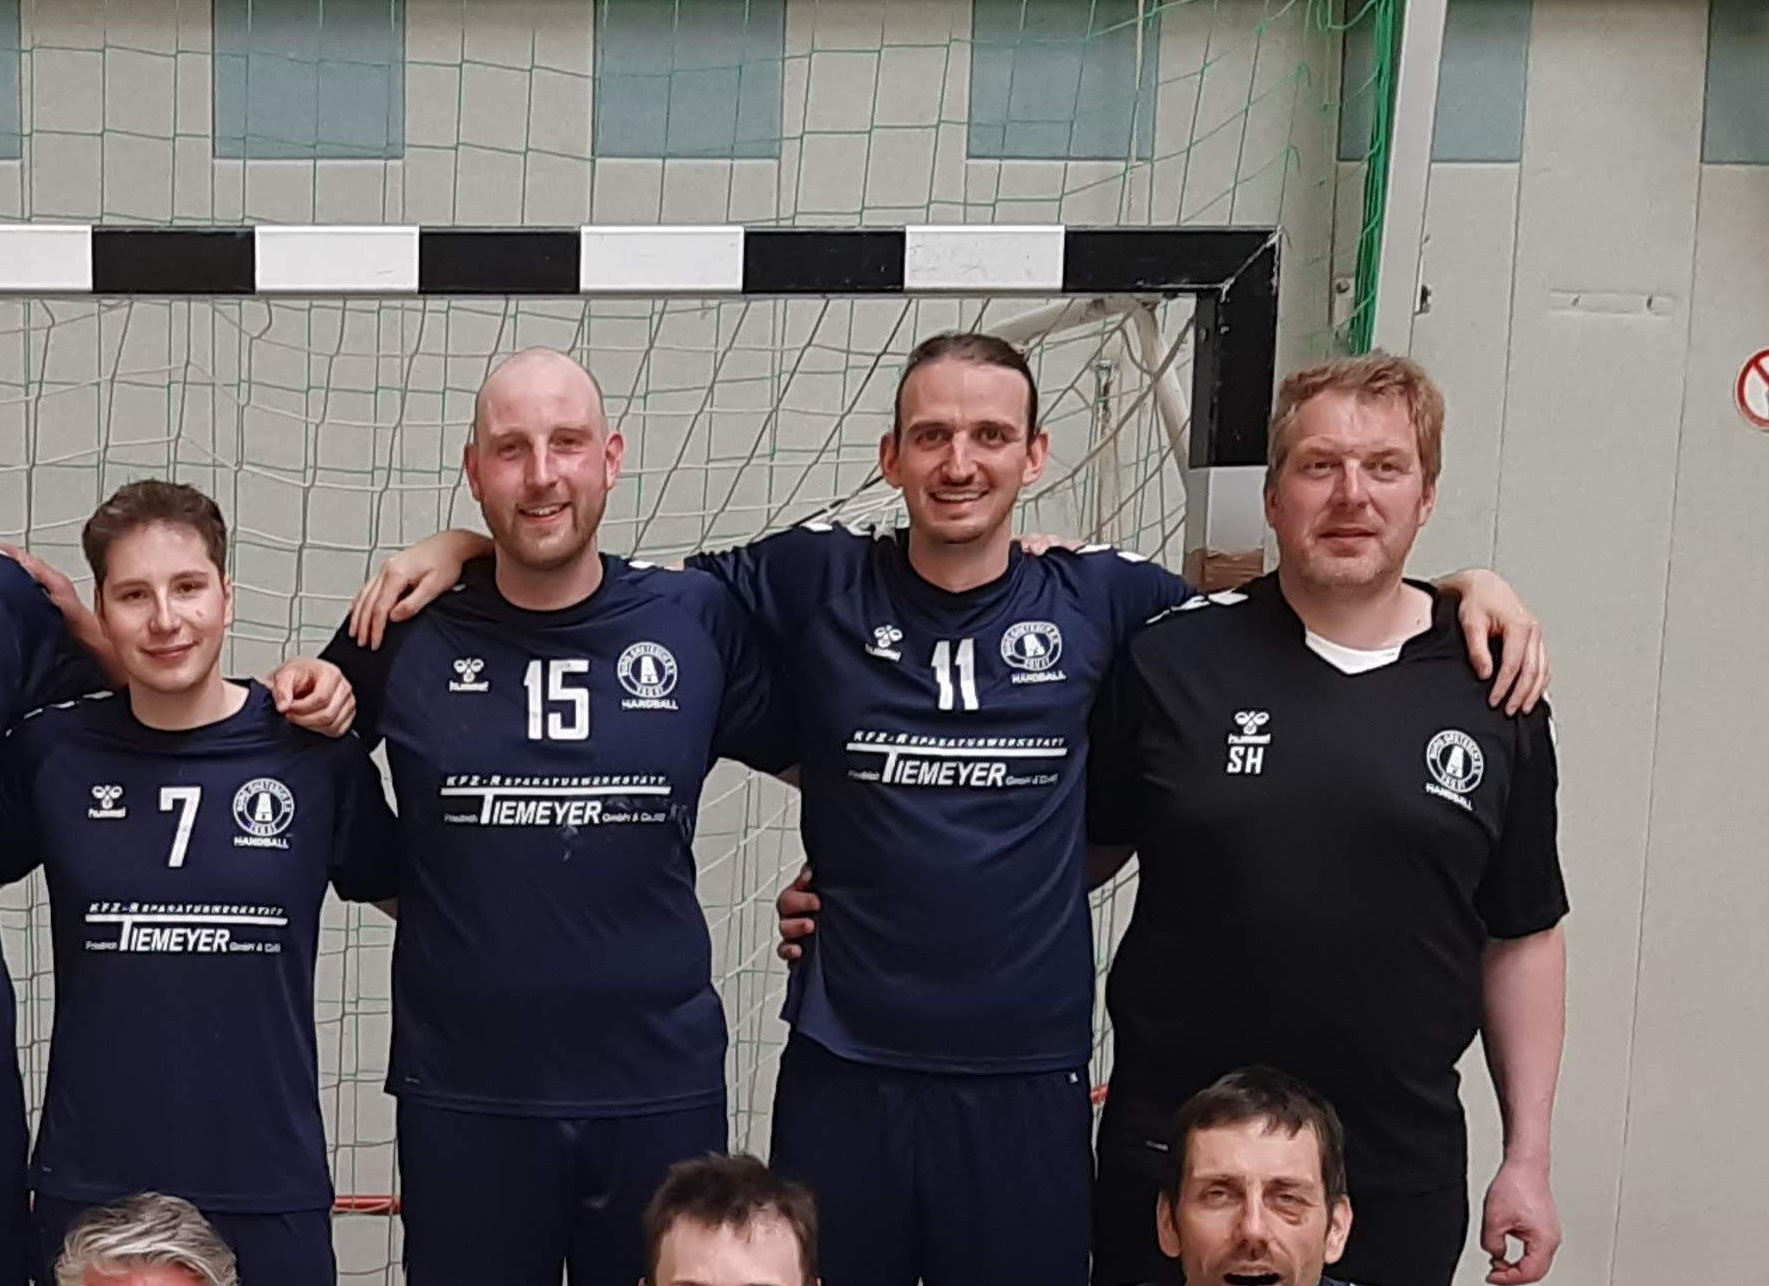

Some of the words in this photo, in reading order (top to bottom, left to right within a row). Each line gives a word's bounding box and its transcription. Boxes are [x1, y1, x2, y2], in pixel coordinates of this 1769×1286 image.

[930, 638, 978, 710] 11
[524, 659, 589, 740] 15
[882, 754, 1006, 786] TIEMEYER
[1227, 747, 1264, 774] SH
[480, 795, 601, 825] TIEMEYER
[159, 786, 202, 867] 7
[119, 923, 230, 952] TIEMEYER
